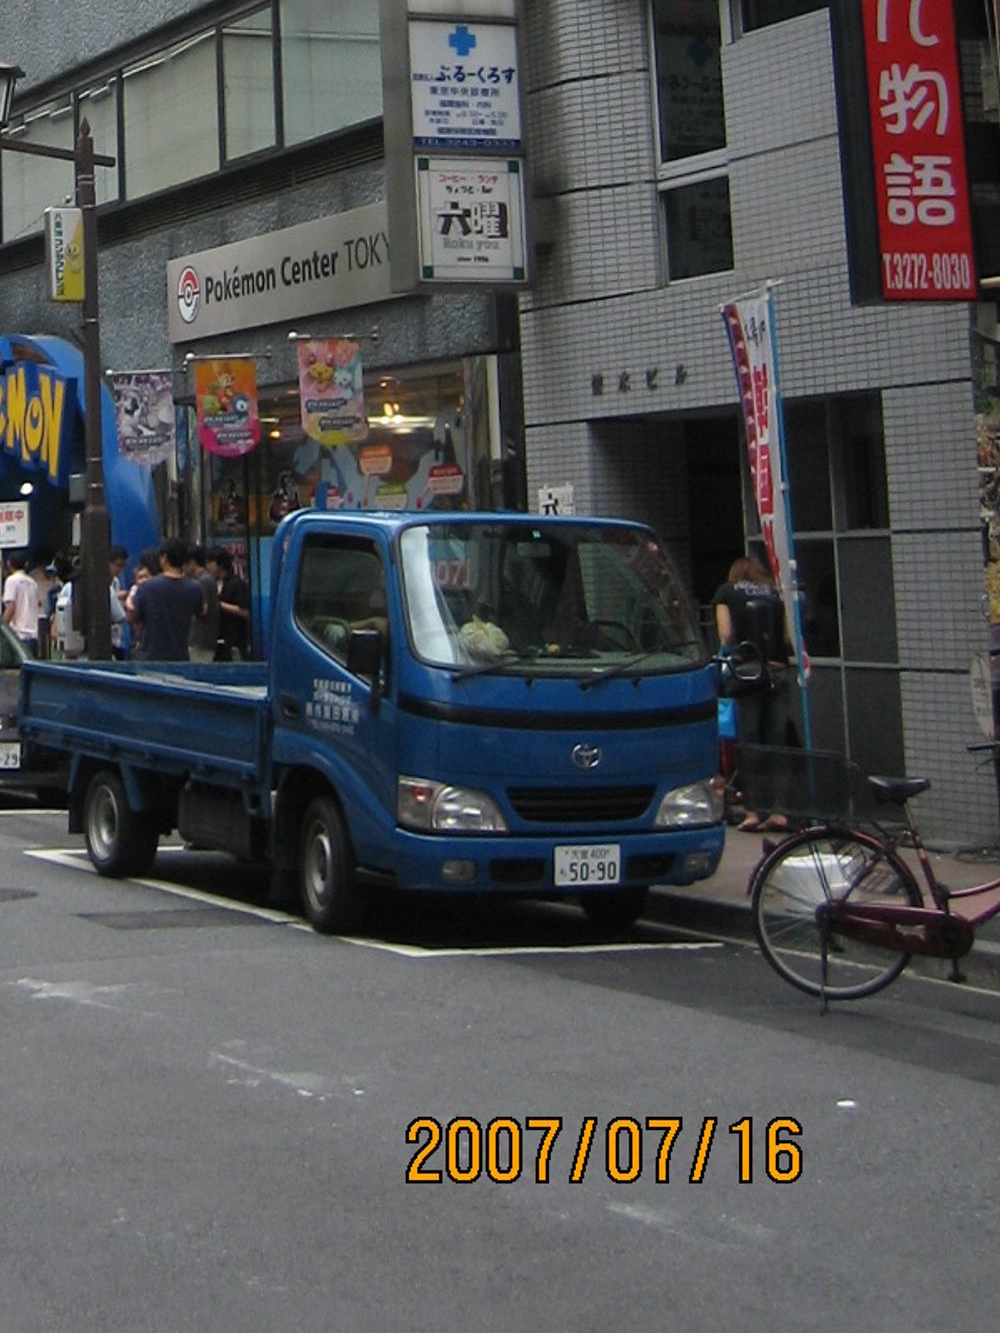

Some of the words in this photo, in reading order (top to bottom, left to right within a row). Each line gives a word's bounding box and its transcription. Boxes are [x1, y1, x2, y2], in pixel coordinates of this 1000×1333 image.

[205, 266, 276, 305] Pokémon
[281, 250, 338, 286] Center
[883, 253, 970, 289] T.3272-8030
[569, 861, 616, 882] 50-90
